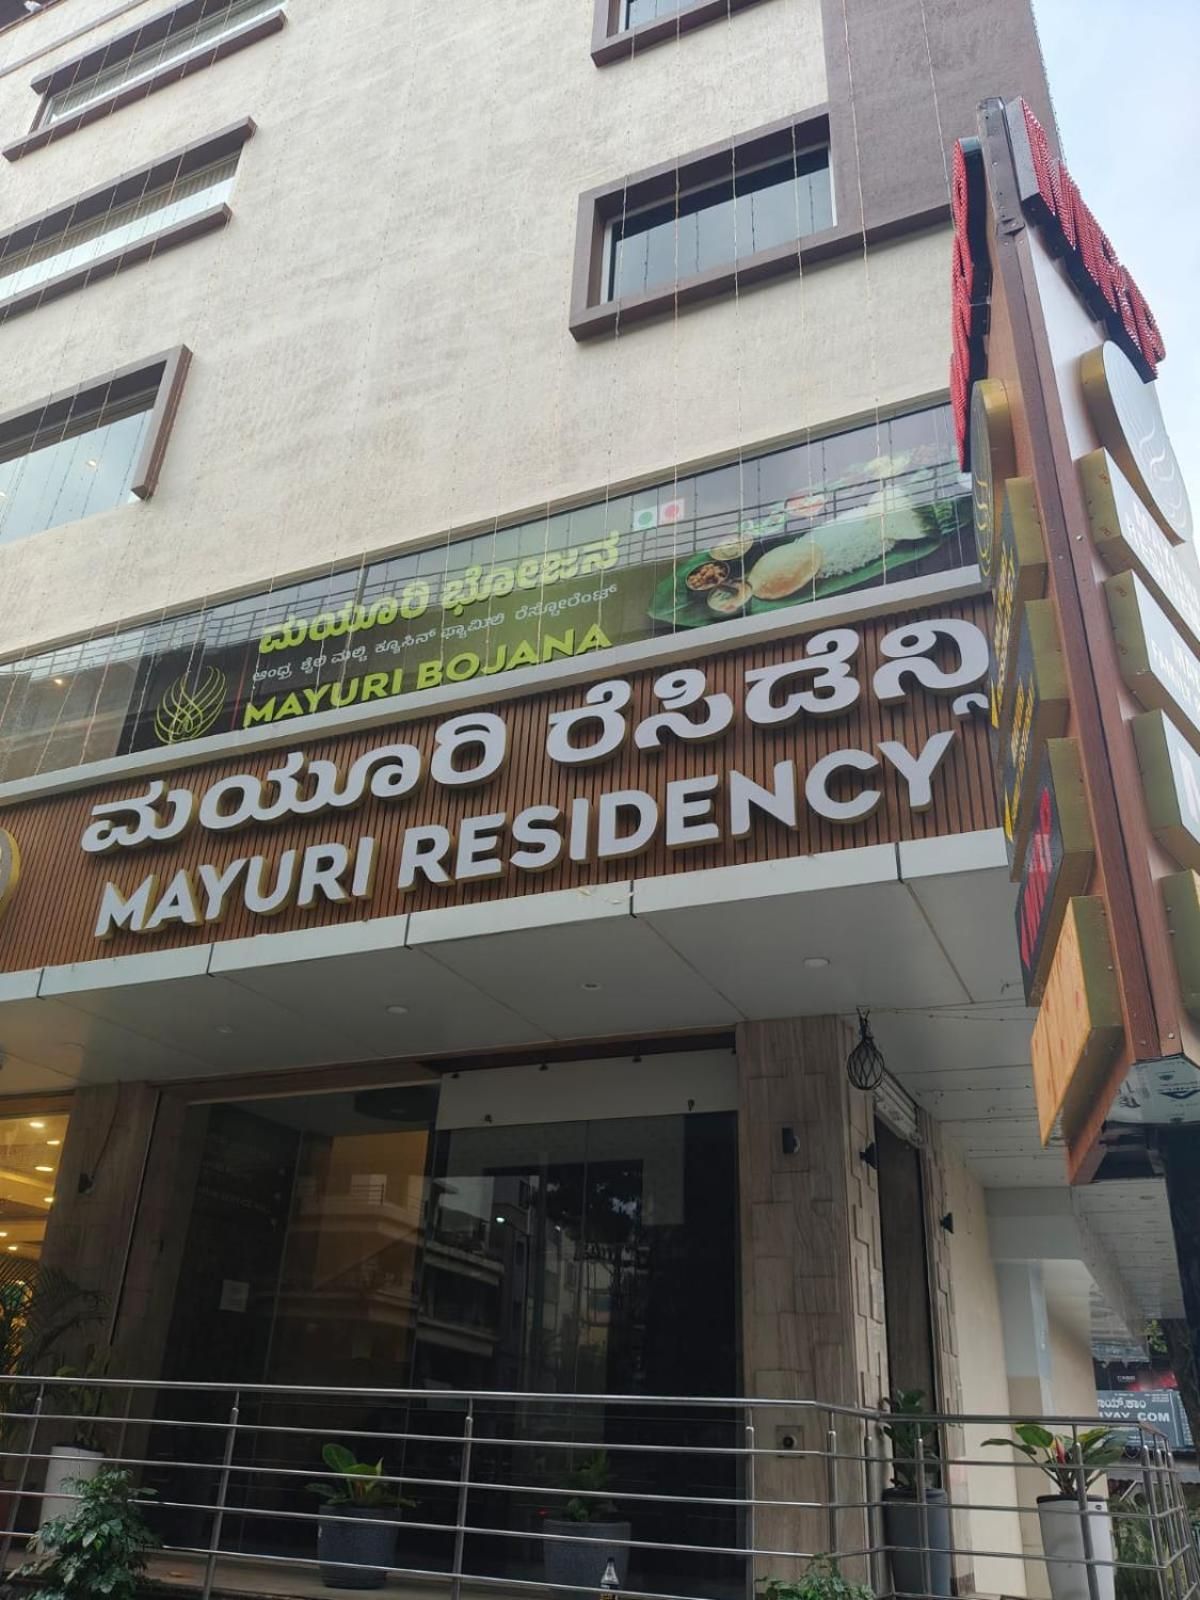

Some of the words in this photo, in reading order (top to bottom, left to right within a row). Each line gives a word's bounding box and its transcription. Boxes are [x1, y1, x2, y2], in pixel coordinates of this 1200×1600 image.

[259, 581, 430, 654] ಮಯೂರಿ
[441, 530, 620, 617] ಭೋಜನ
[81, 711, 508, 854] ಮಯೂರಿ
[545, 618, 990, 766] ರೆಸಿಡೆನ್ಸಿ
[242, 668, 404, 729] MAYURI
[416, 623, 613, 690] BOJANA
[94, 836, 376, 939] MAYURI
[397, 730, 956, 891] RESIDENCY
